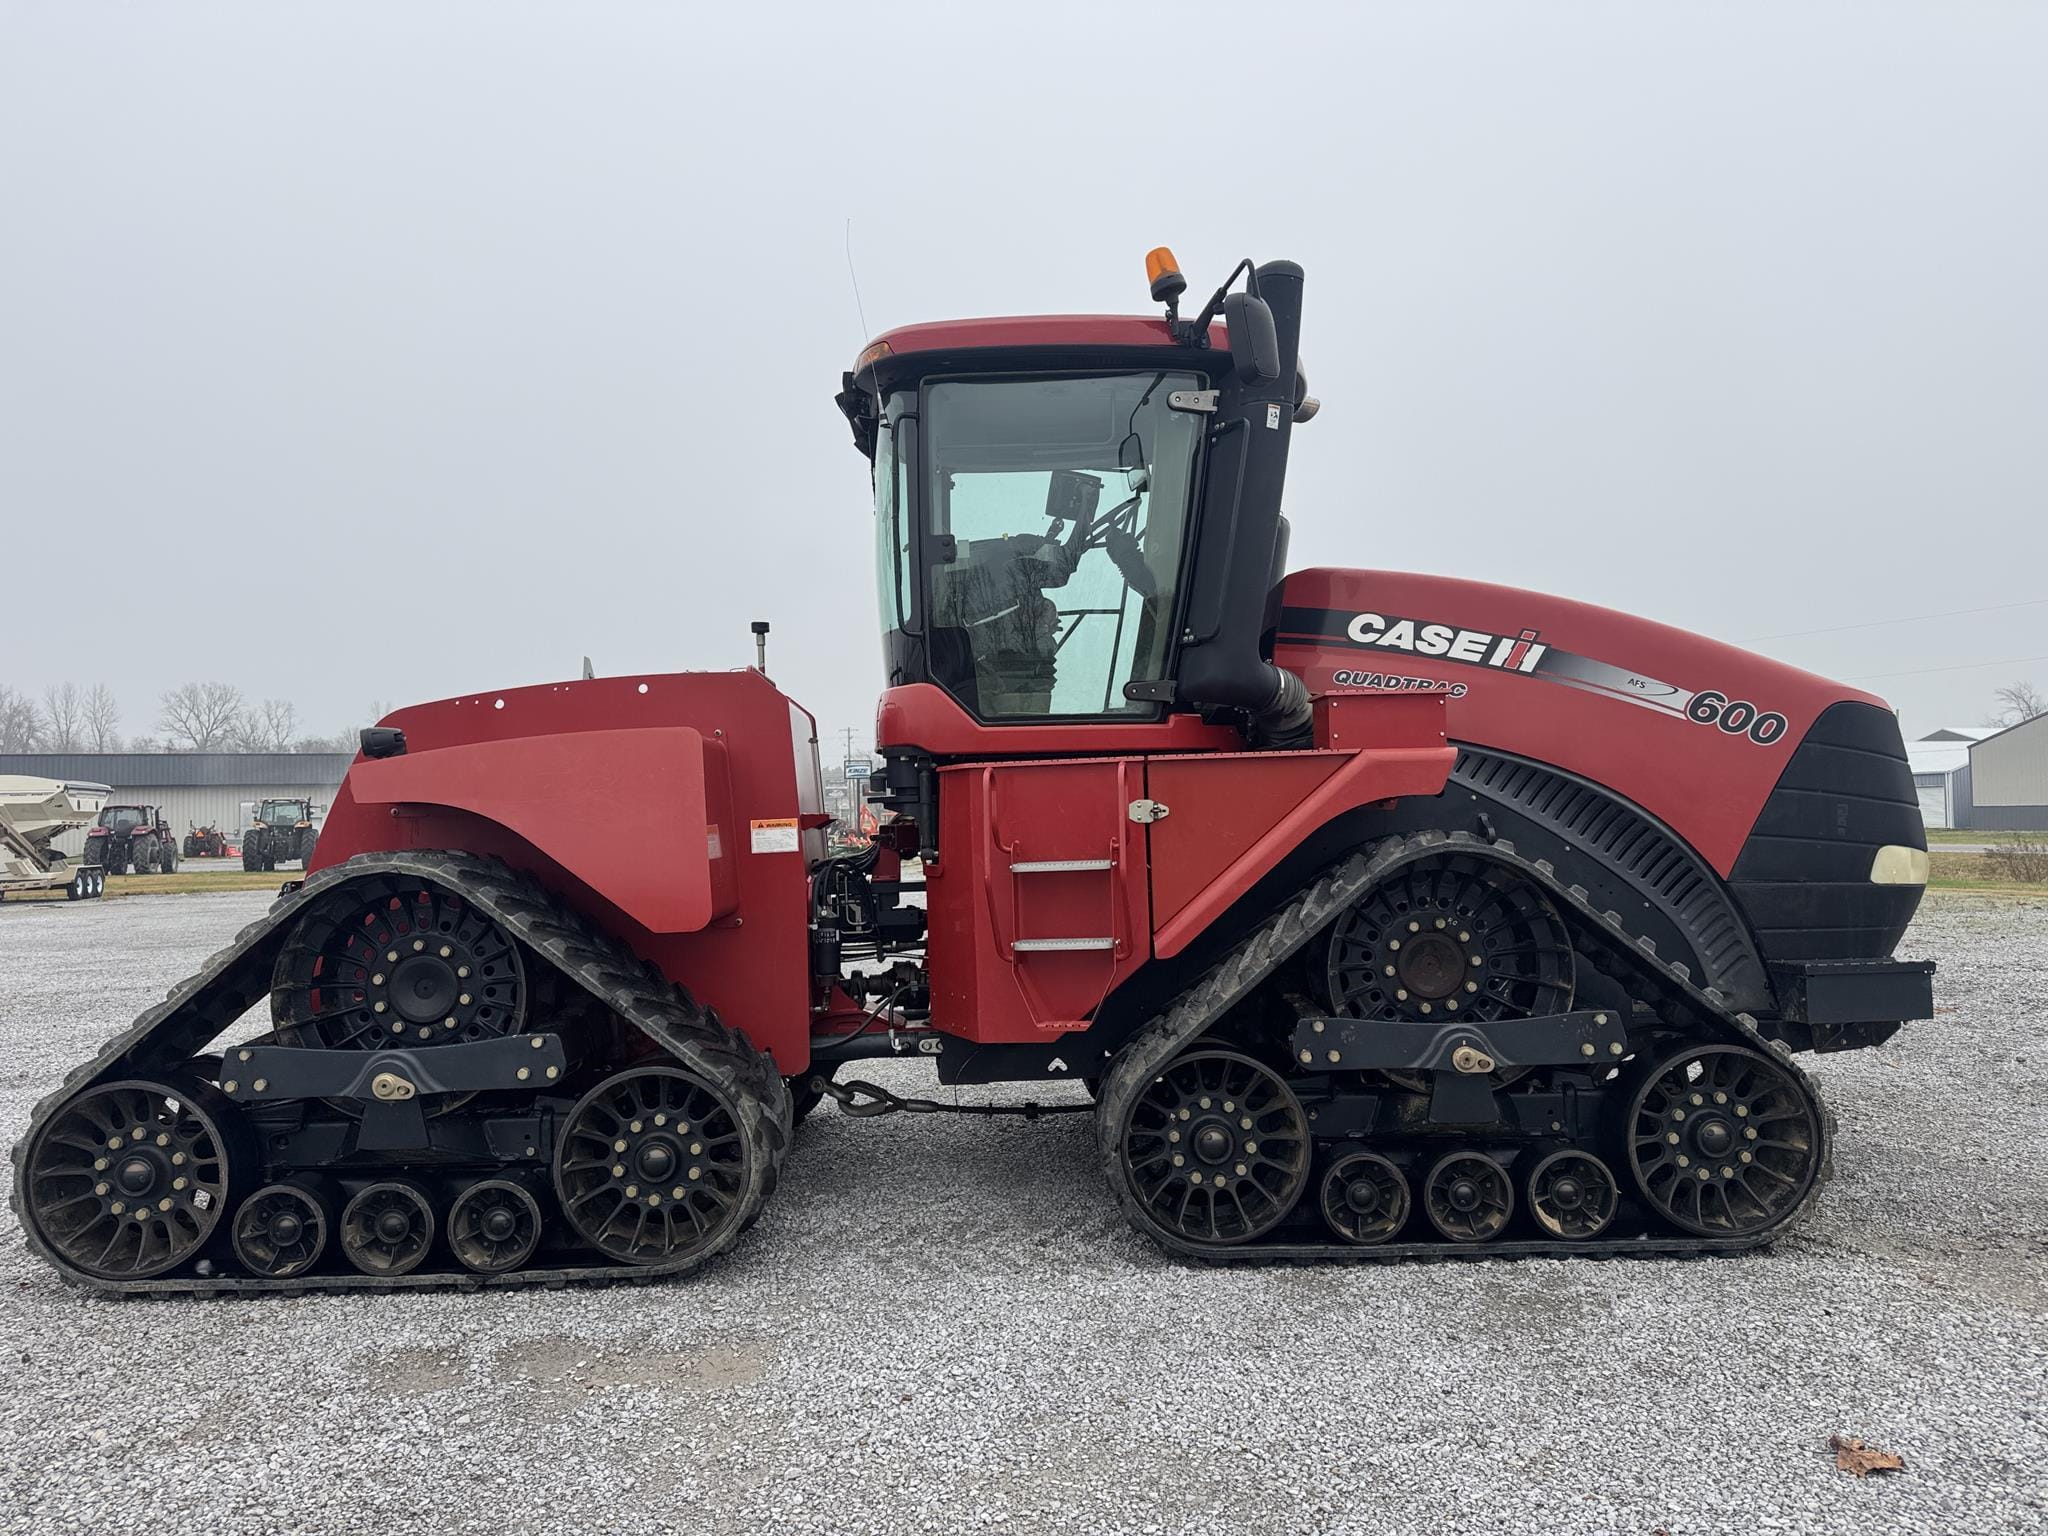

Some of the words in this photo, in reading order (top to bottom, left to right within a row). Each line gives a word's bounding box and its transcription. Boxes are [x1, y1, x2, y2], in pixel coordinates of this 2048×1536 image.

[1347, 613, 1493, 662] CASE
[1627, 678, 1646, 689] AFS
[1687, 690, 1788, 746] 600
